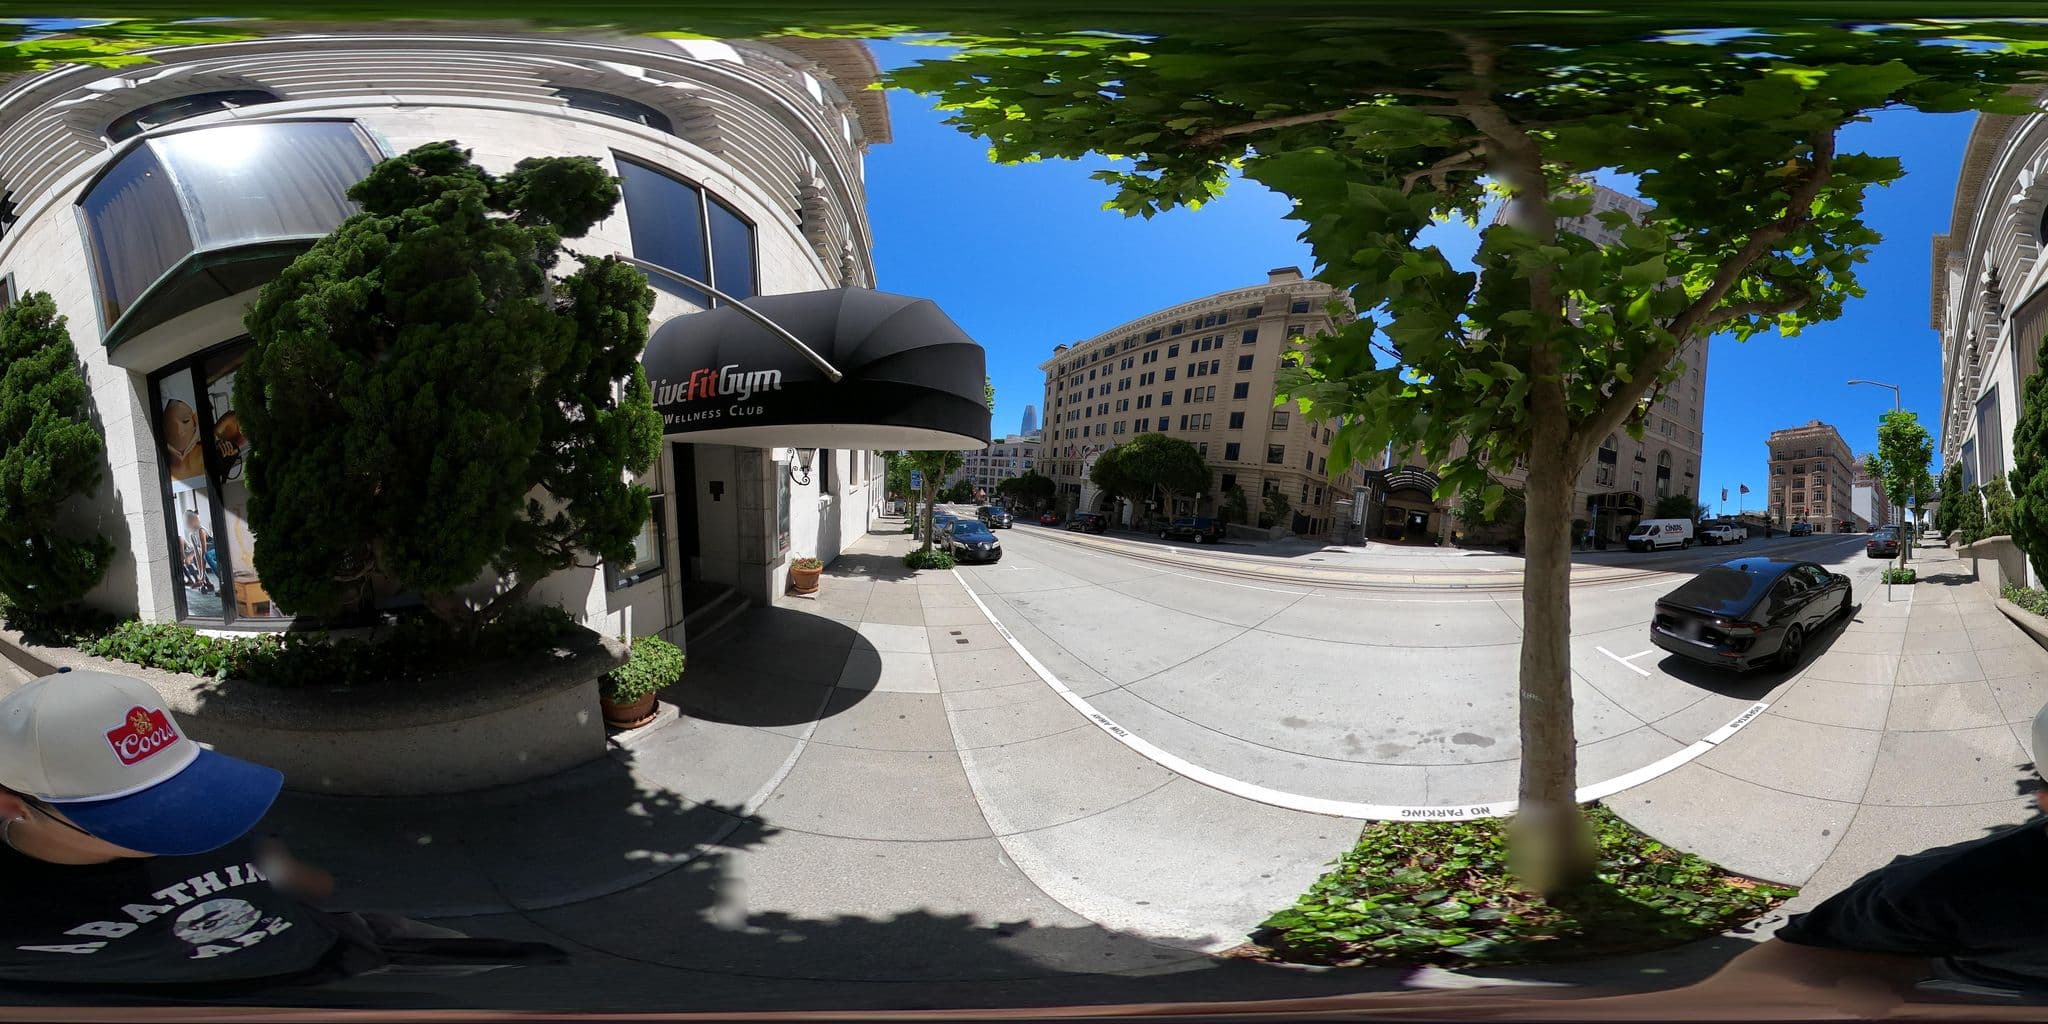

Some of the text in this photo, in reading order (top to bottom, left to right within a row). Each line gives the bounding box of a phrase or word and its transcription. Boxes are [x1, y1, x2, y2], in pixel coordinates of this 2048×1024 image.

[114, 722, 175, 759] Coors
[1401, 806, 1491, 818] NO PARKING
[189, 916, 294, 959] APE
